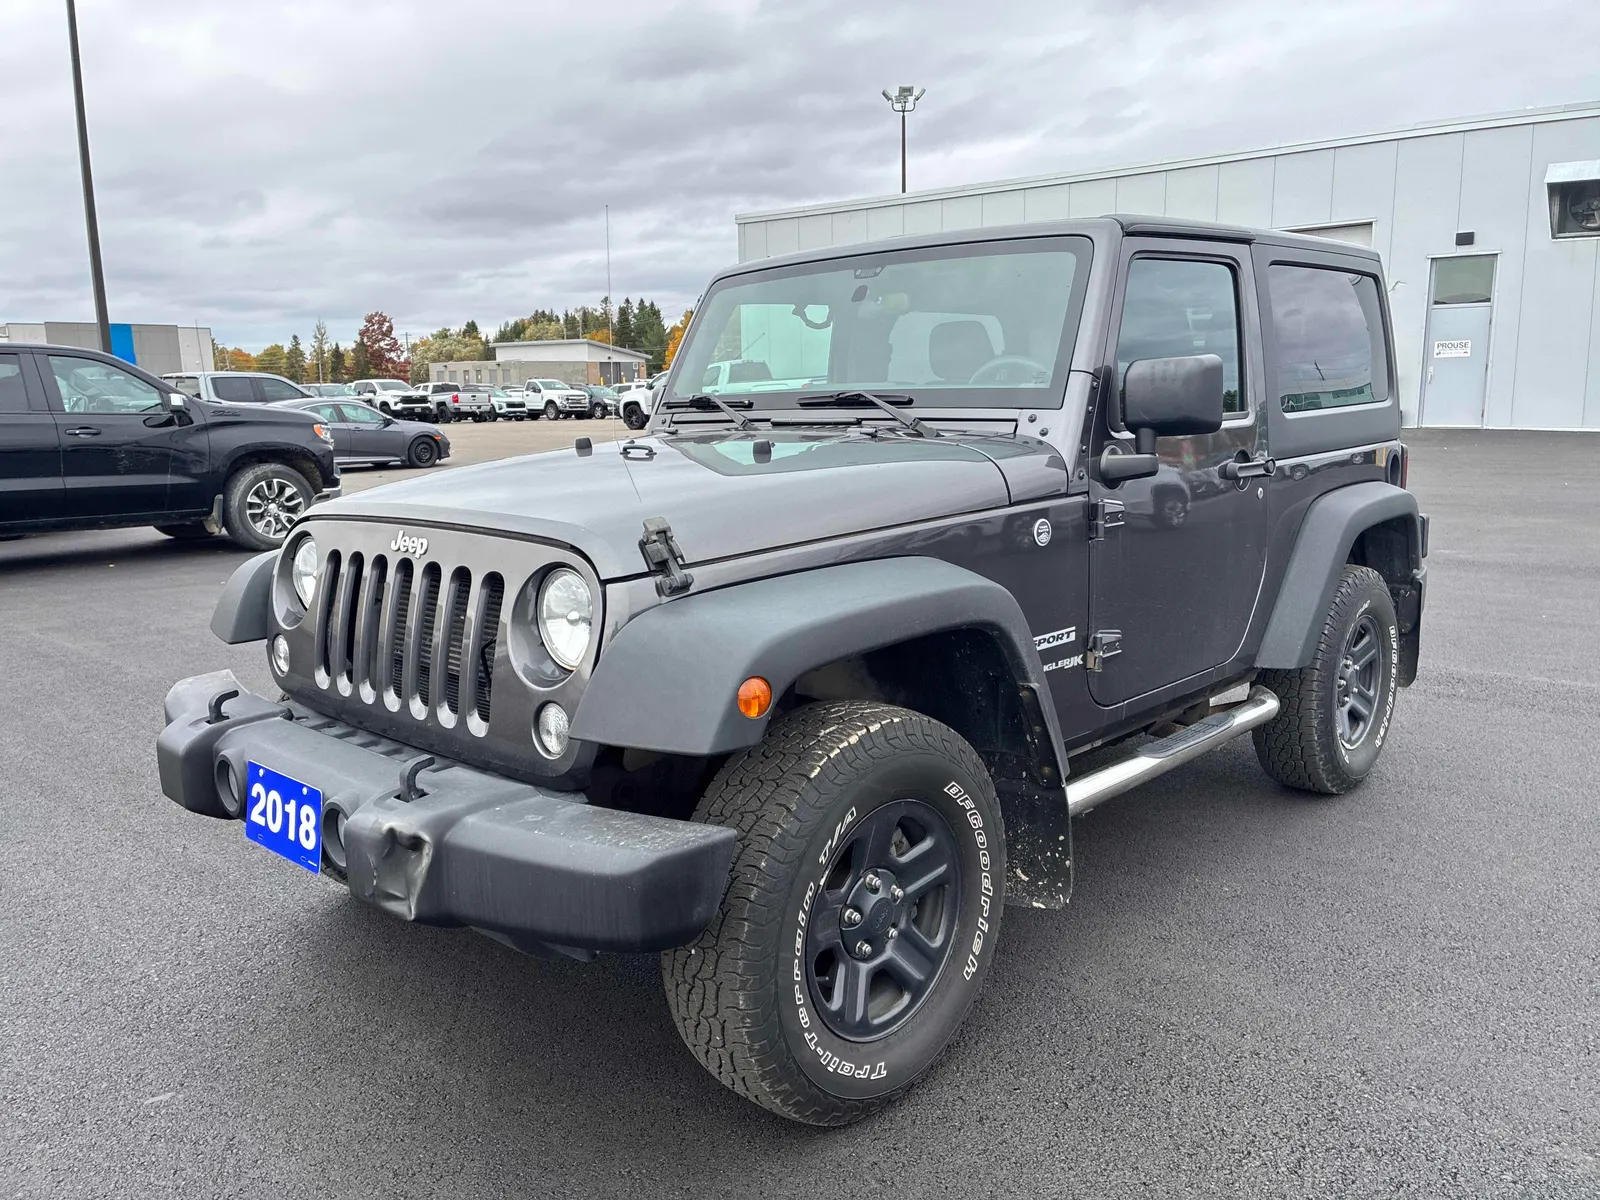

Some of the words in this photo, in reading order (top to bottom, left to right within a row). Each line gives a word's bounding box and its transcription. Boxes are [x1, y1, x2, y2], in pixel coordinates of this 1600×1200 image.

[1437, 341, 1469, 349] PROUSE
[390, 530, 428, 559] Jeep
[250, 782, 316, 851] 2018
[818, 806, 857, 865] T/A
[944, 781, 993, 981] BFGoodrich
